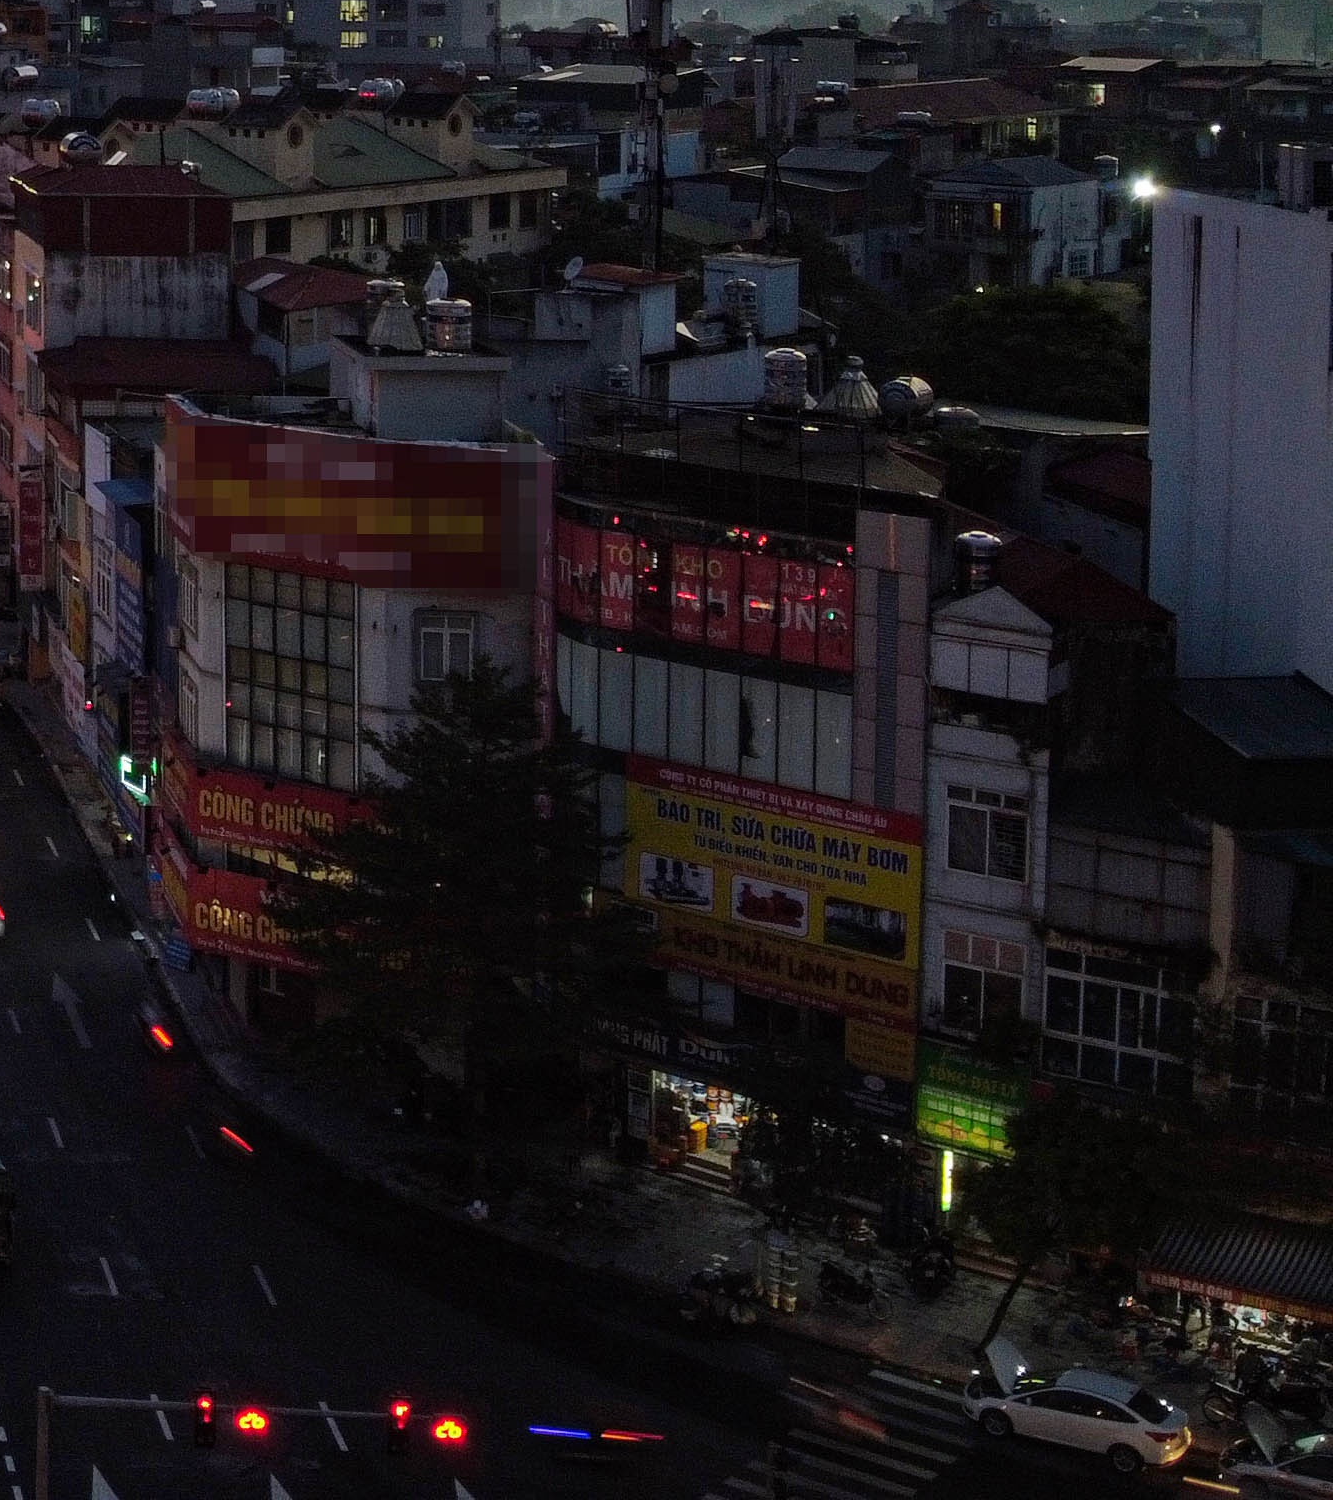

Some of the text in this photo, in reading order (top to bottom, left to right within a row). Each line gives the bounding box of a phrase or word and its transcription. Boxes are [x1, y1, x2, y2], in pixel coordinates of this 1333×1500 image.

[198, 784, 254, 826] CÔNG
[260, 798, 334, 837] CHỨNG
[657, 795, 690, 824] BẢO
[732, 814, 765, 841] SỬA
[771, 824, 816, 854] CHỮA
[822, 836, 862, 865] MÁY
[867, 846, 909, 875] BƠM
[194, 898, 254, 941] CÔNG
